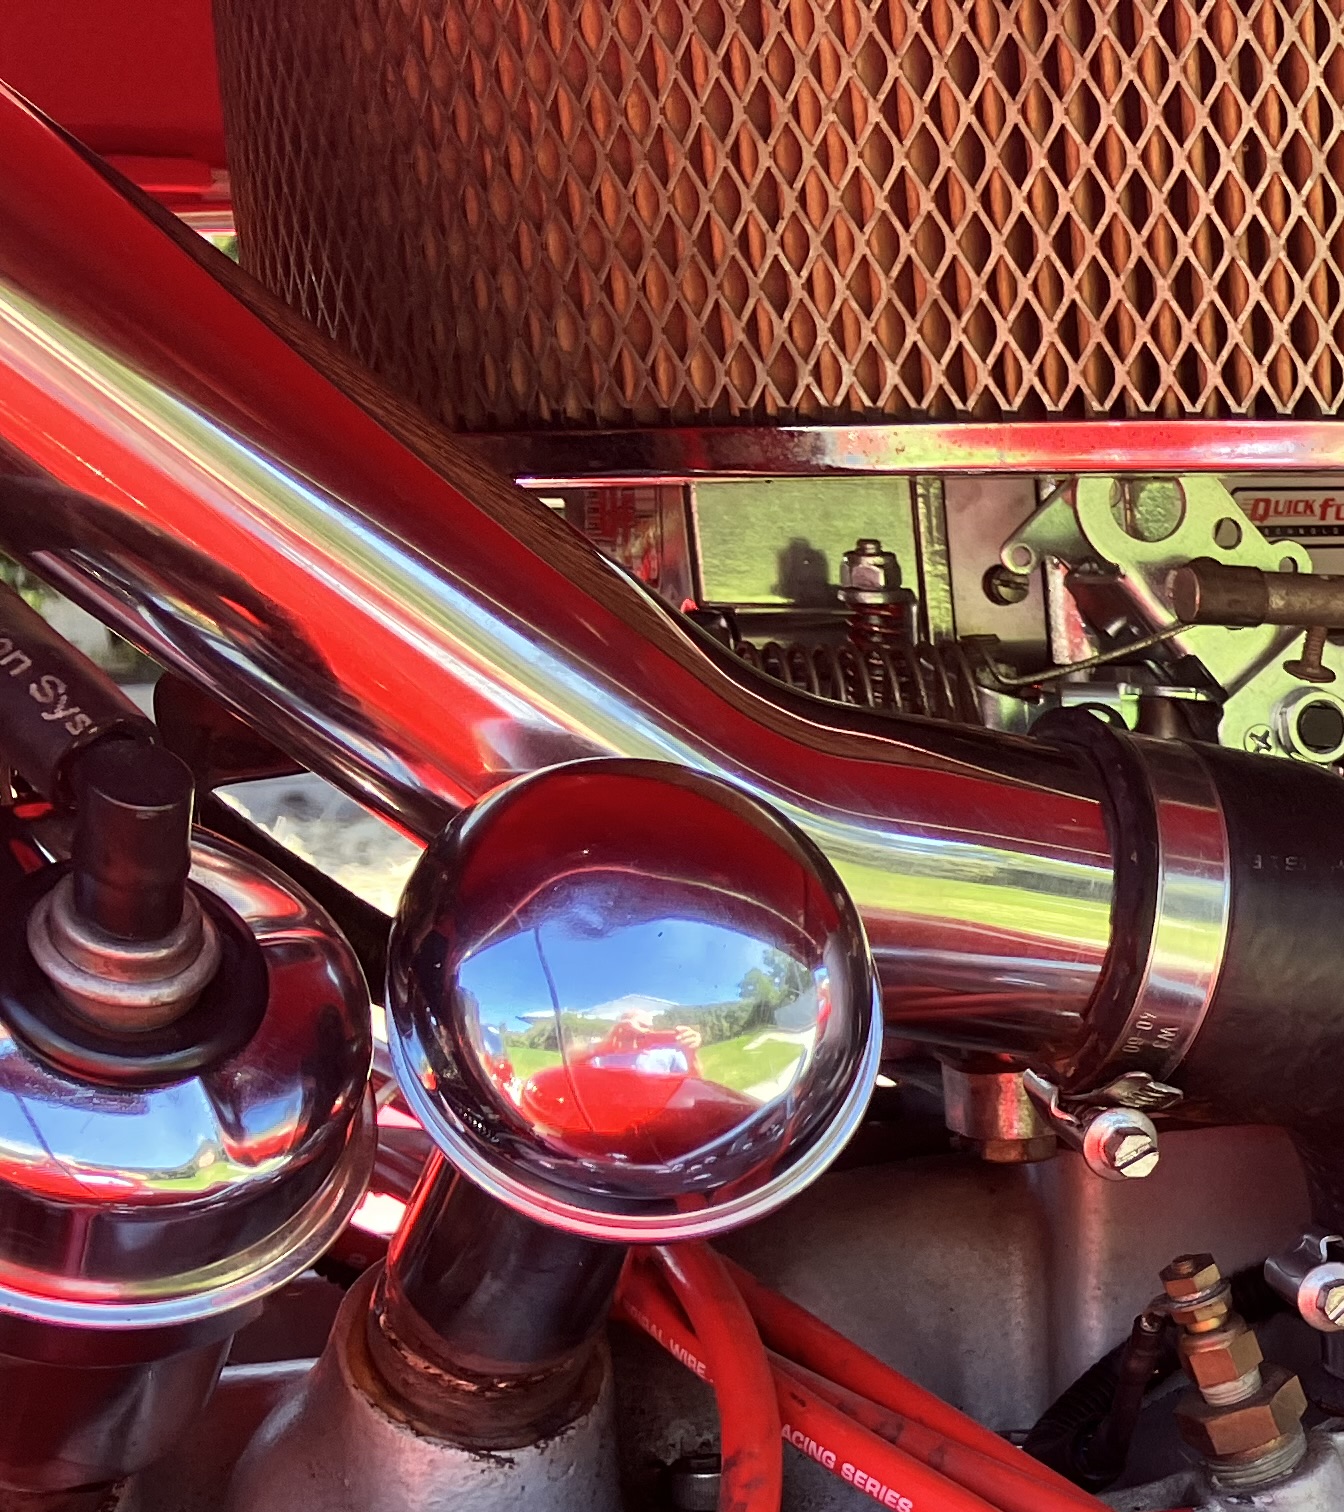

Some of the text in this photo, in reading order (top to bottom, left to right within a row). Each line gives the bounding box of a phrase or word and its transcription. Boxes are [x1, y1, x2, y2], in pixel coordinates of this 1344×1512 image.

[1250, 497, 1316, 523] QUICK
[29, 675, 98, 736] Sys
[670, 1338, 707, 1379] WIRE
[781, 1423, 836, 1469] ACING
